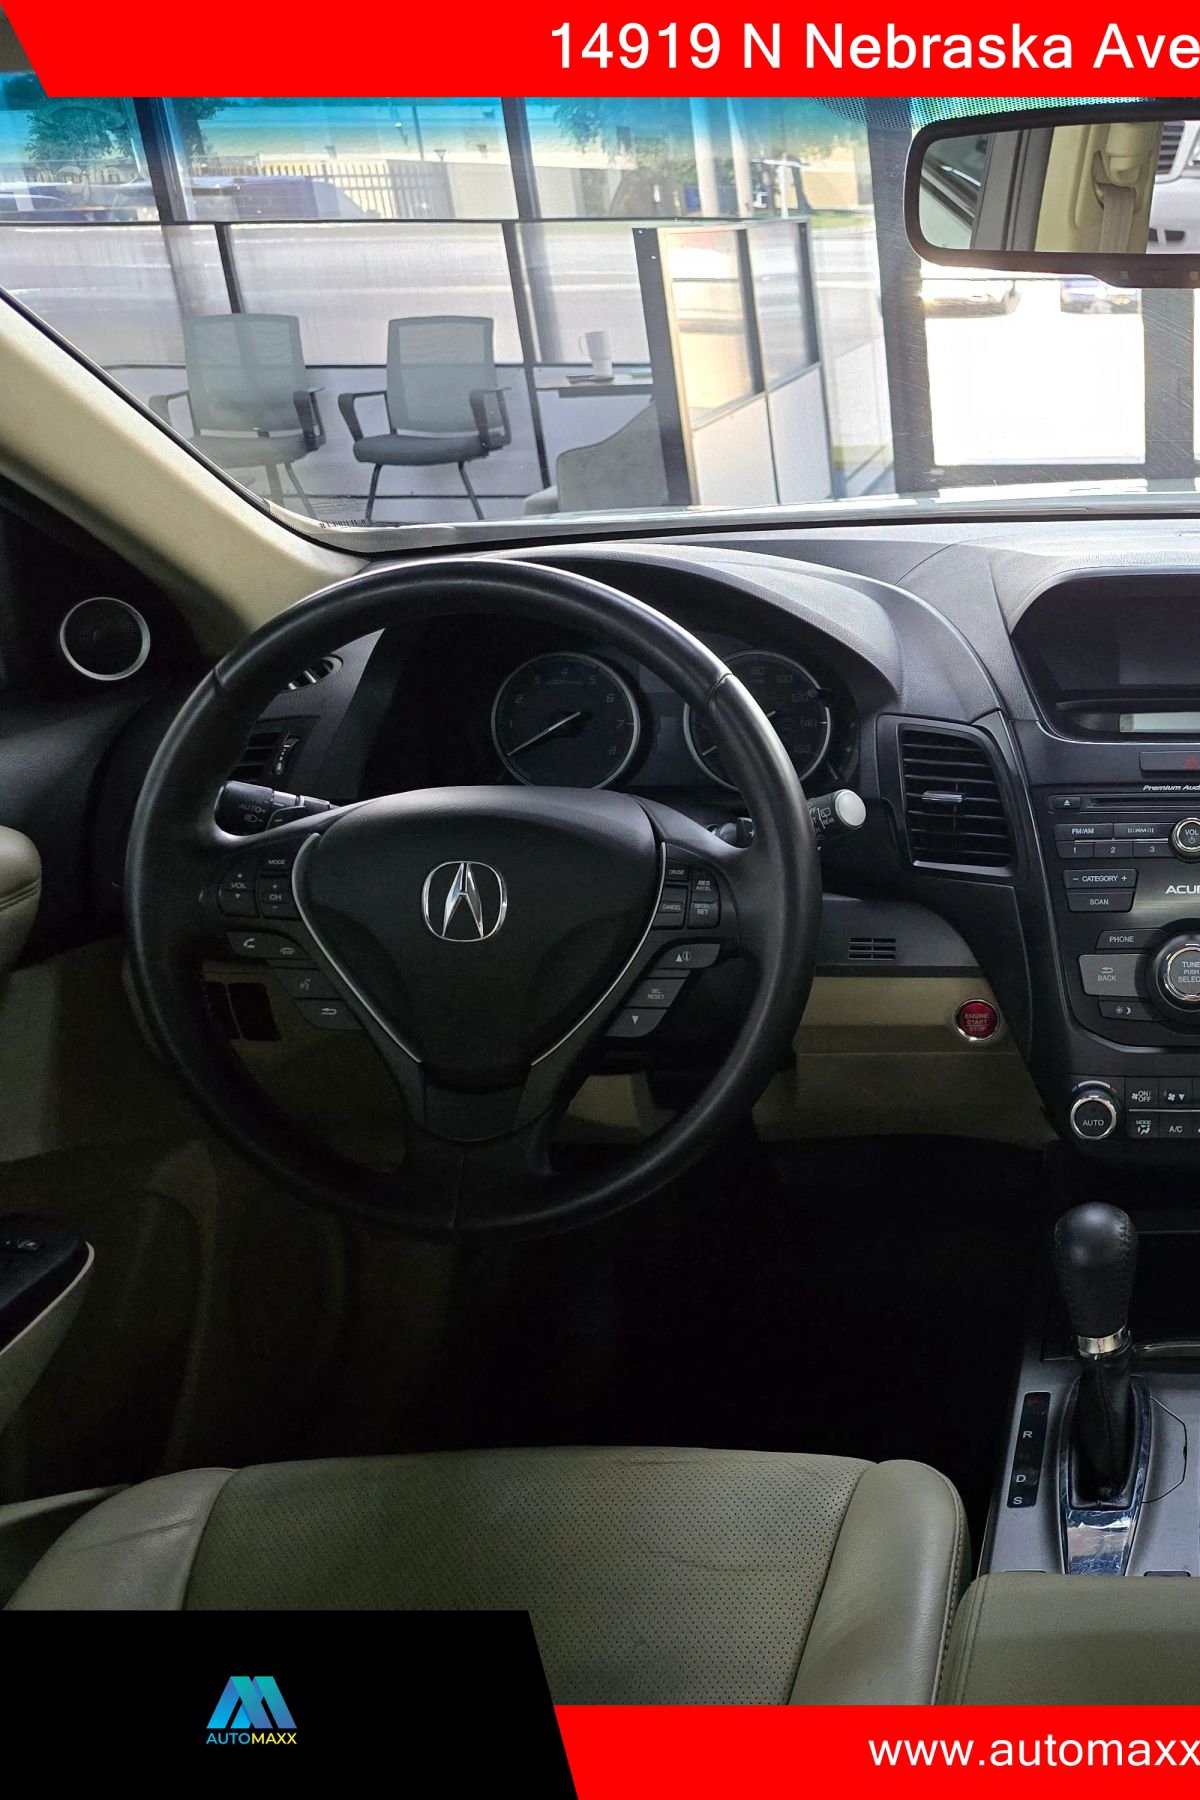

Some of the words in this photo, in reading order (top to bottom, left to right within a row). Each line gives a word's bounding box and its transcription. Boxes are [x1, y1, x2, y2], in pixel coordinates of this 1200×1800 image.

[515, 694, 524, 704] 2
[606, 693, 615, 703] 6
[616, 719, 624, 729] 7
[609, 745, 616, 755] 8
[239, 803, 262, 813] AUTO
[1150, 845, 1155, 853] 3
[1081, 874, 1118, 882] CATEGORY
[230, 881, 247, 889] VOL
[269, 893, 282, 901] CH
[1089, 898, 1109, 906] SCAN
[662, 903, 682, 911] CANCEL
[1108, 935, 1135, 943] PHONE
[1181, 961, 1200, 969] TUNE
[1097, 974, 1117, 983] BACK
[1082, 1119, 1105, 1127] AUTO
[1168, 1125, 1183, 1133] A/C
[1022, 1430, 1033, 1439] R
[1015, 1474, 1026, 1483] D
[1012, 1496, 1023, 1505] S
